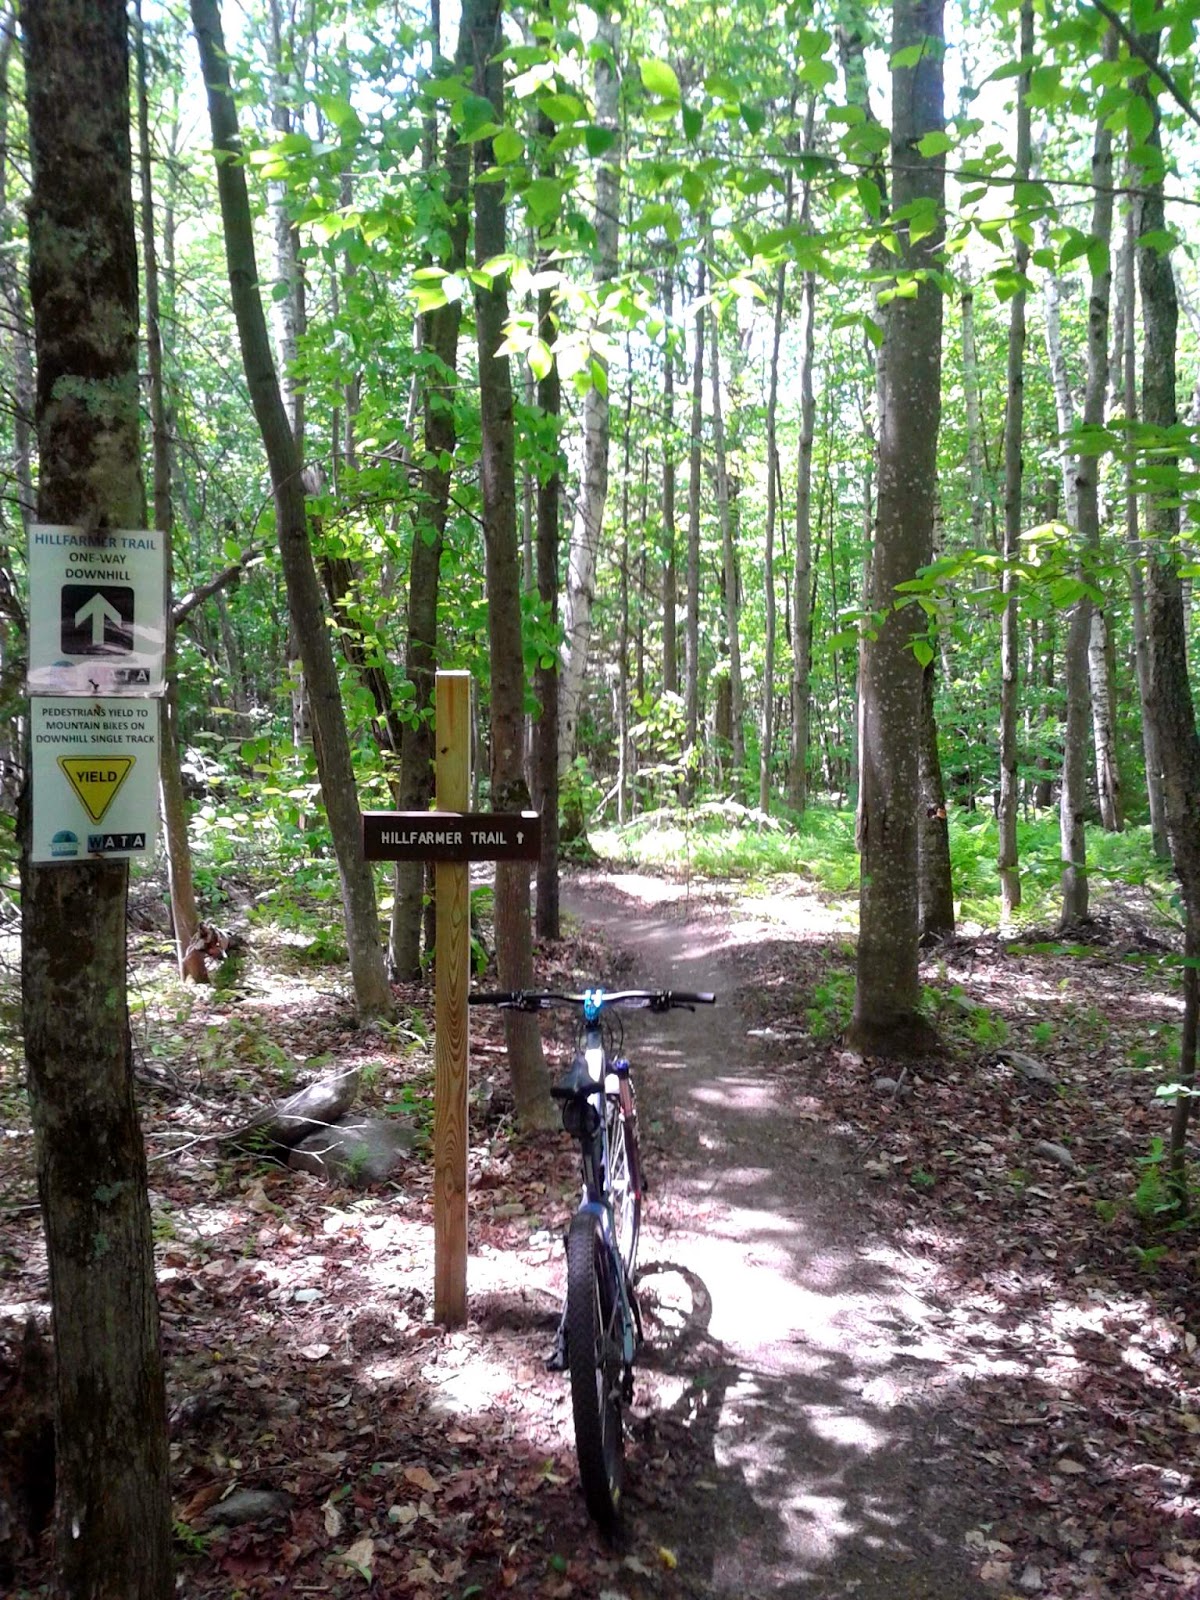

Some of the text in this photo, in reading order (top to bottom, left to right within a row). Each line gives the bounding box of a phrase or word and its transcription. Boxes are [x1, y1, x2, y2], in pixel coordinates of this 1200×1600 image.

[121, 537, 157, 551] TRAIL
[69, 551, 127, 564] ONE-WAY
[65, 568, 131, 581] DOWNHILL
[42, 707, 149, 717] PEDESTRIANS YIELD TO
[46, 721, 145, 730] MOUNTAIN BIKES ON
[36, 734, 155, 744] DOWNHILL SINGLE TRACK
[76, 771, 118, 783] YIELD
[88, 834, 144, 849] WATA
[381, 831, 507, 845] HILLFARMER TRAIL
